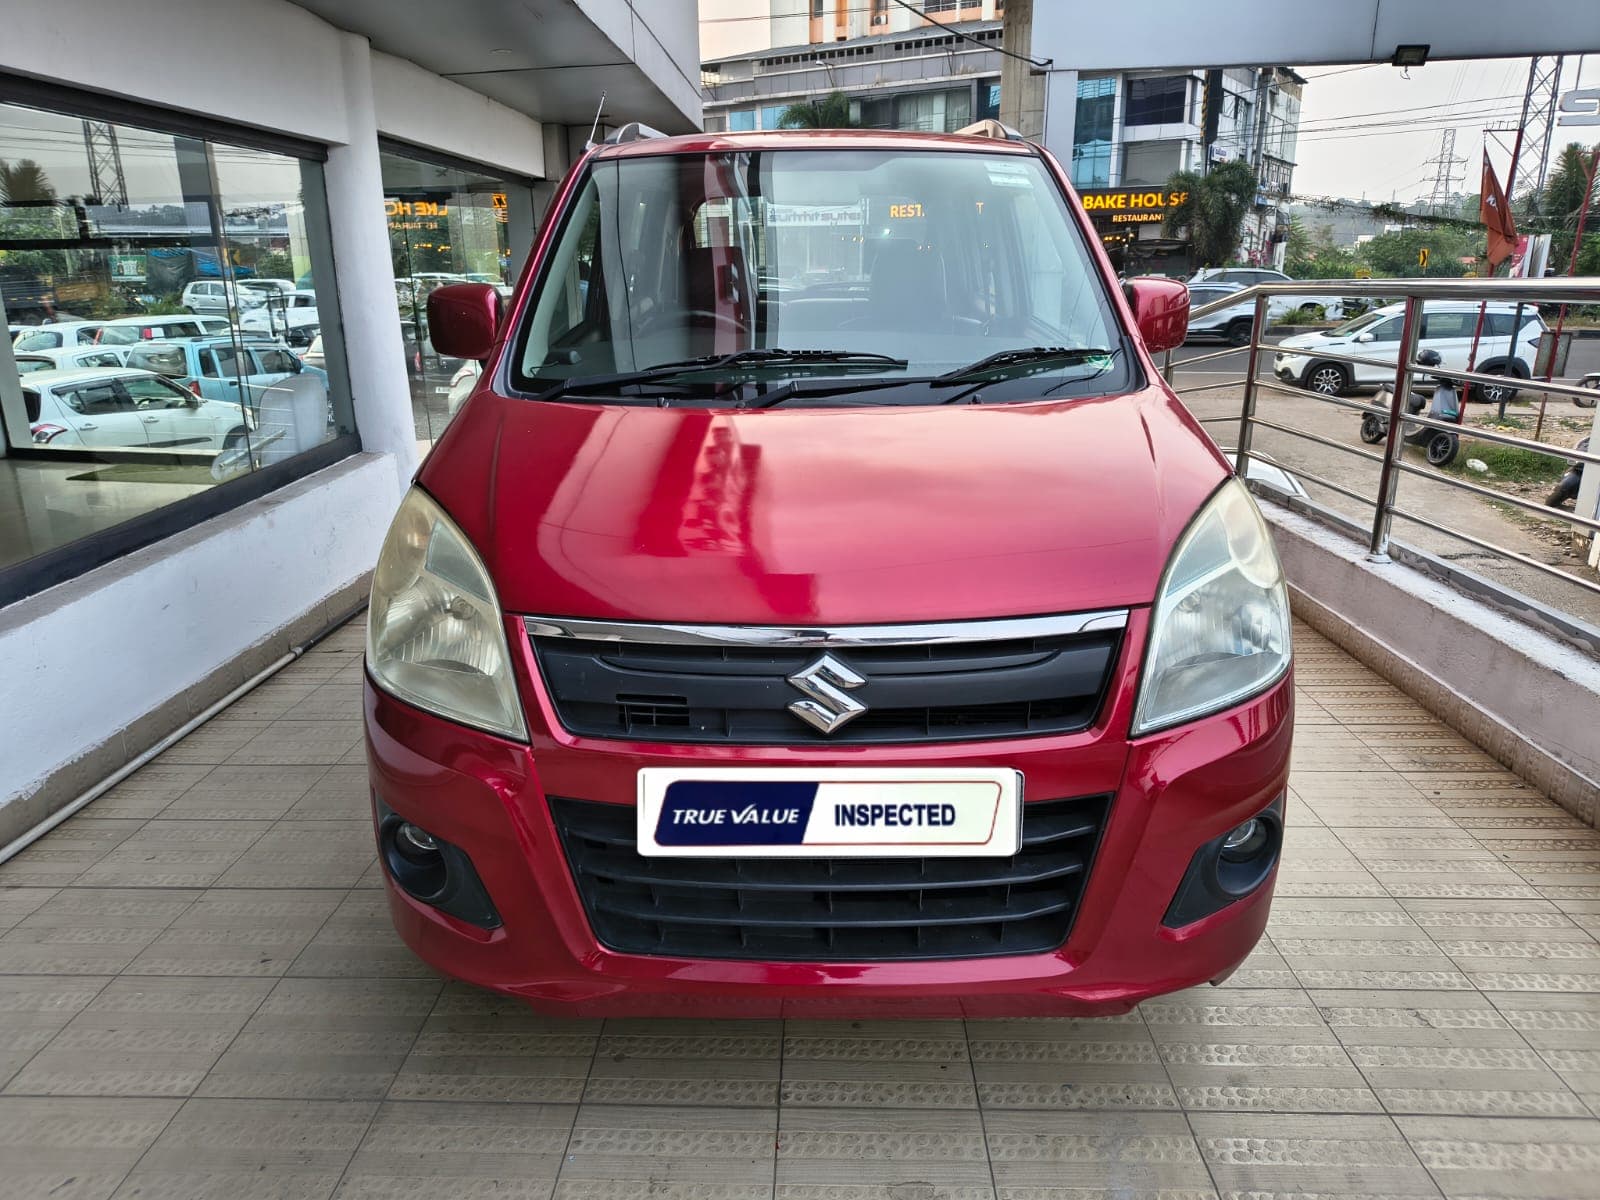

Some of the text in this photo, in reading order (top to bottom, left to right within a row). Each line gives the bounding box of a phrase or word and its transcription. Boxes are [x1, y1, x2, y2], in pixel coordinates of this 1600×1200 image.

[1083, 194, 1127, 210] BAKE
[1112, 213, 1165, 223] RESTAURAN
[672, 804, 800, 825] TRUE VALUE
[834, 804, 956, 827] INSPECTED
